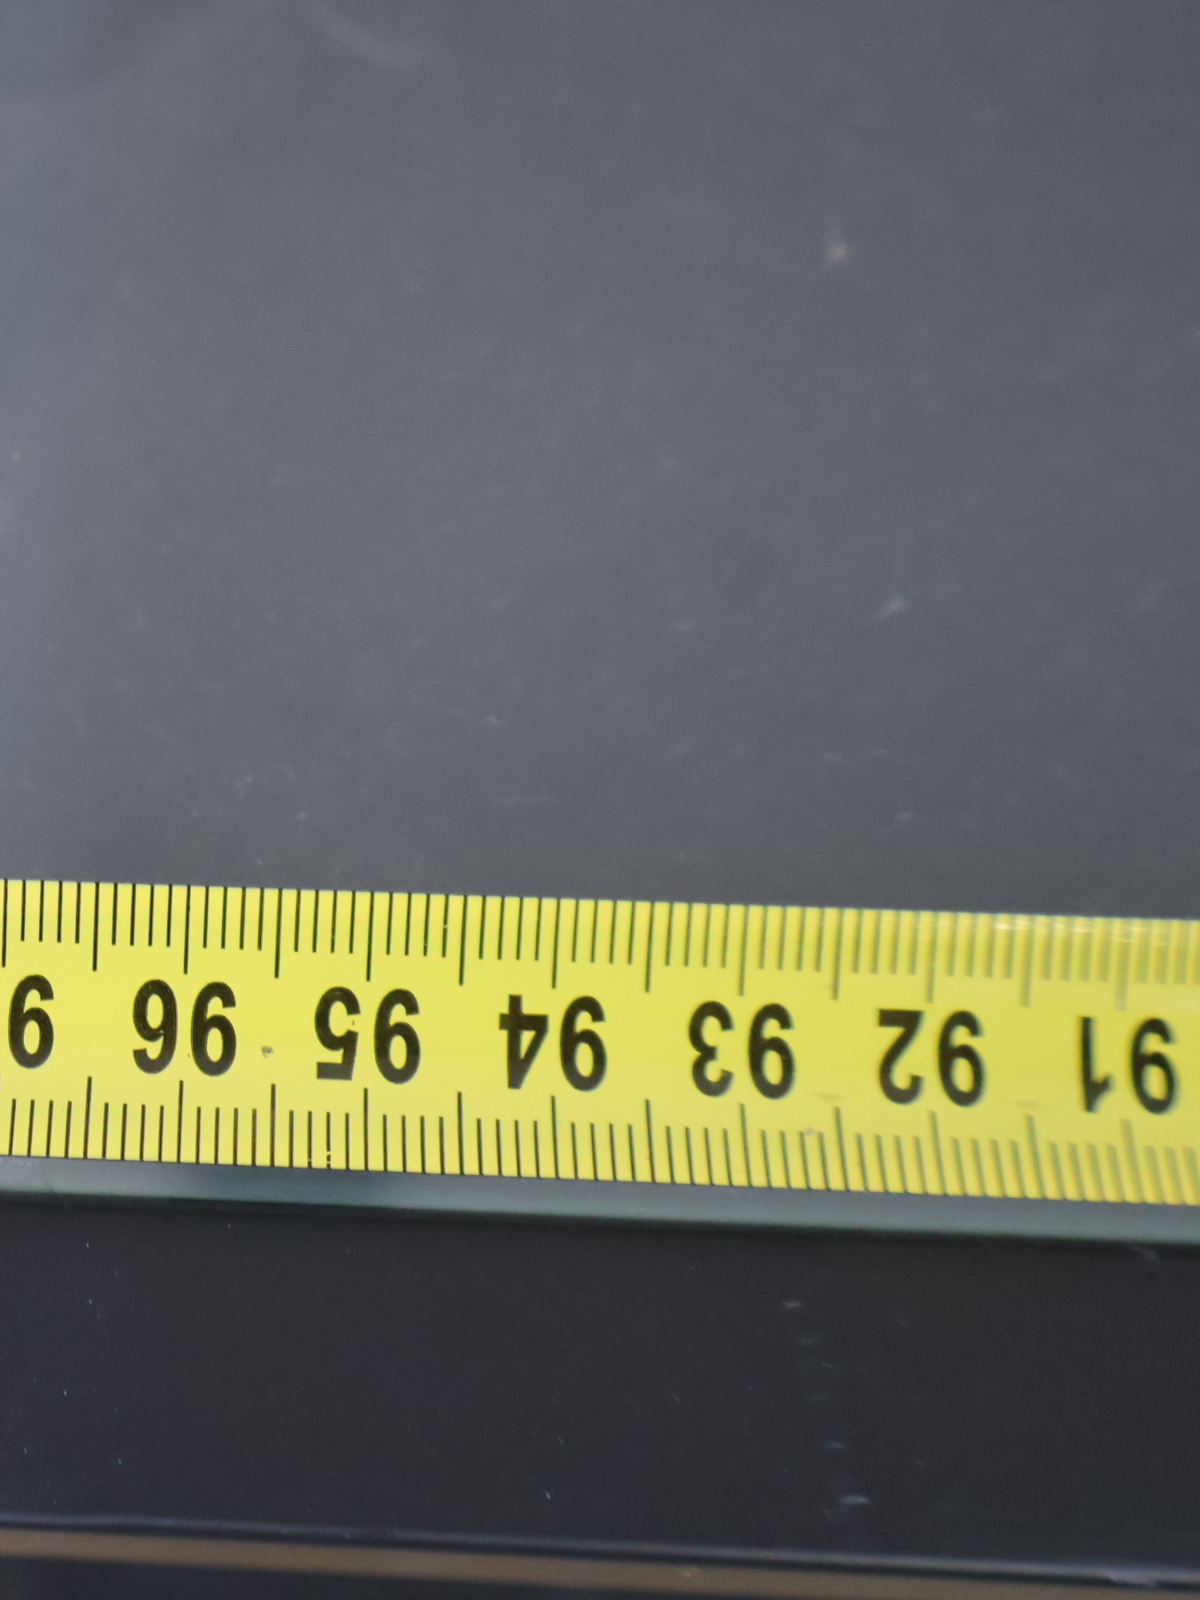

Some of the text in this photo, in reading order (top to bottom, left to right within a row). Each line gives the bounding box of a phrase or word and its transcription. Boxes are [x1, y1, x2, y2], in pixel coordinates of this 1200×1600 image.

[132, 979, 237, 1077] 96
[314, 986, 421, 1084] 95
[499, 994, 607, 1092] 94
[688, 1001, 796, 1099] 93
[878, 1008, 986, 1107] 92
[1080, 1016, 1177, 1115] 91
